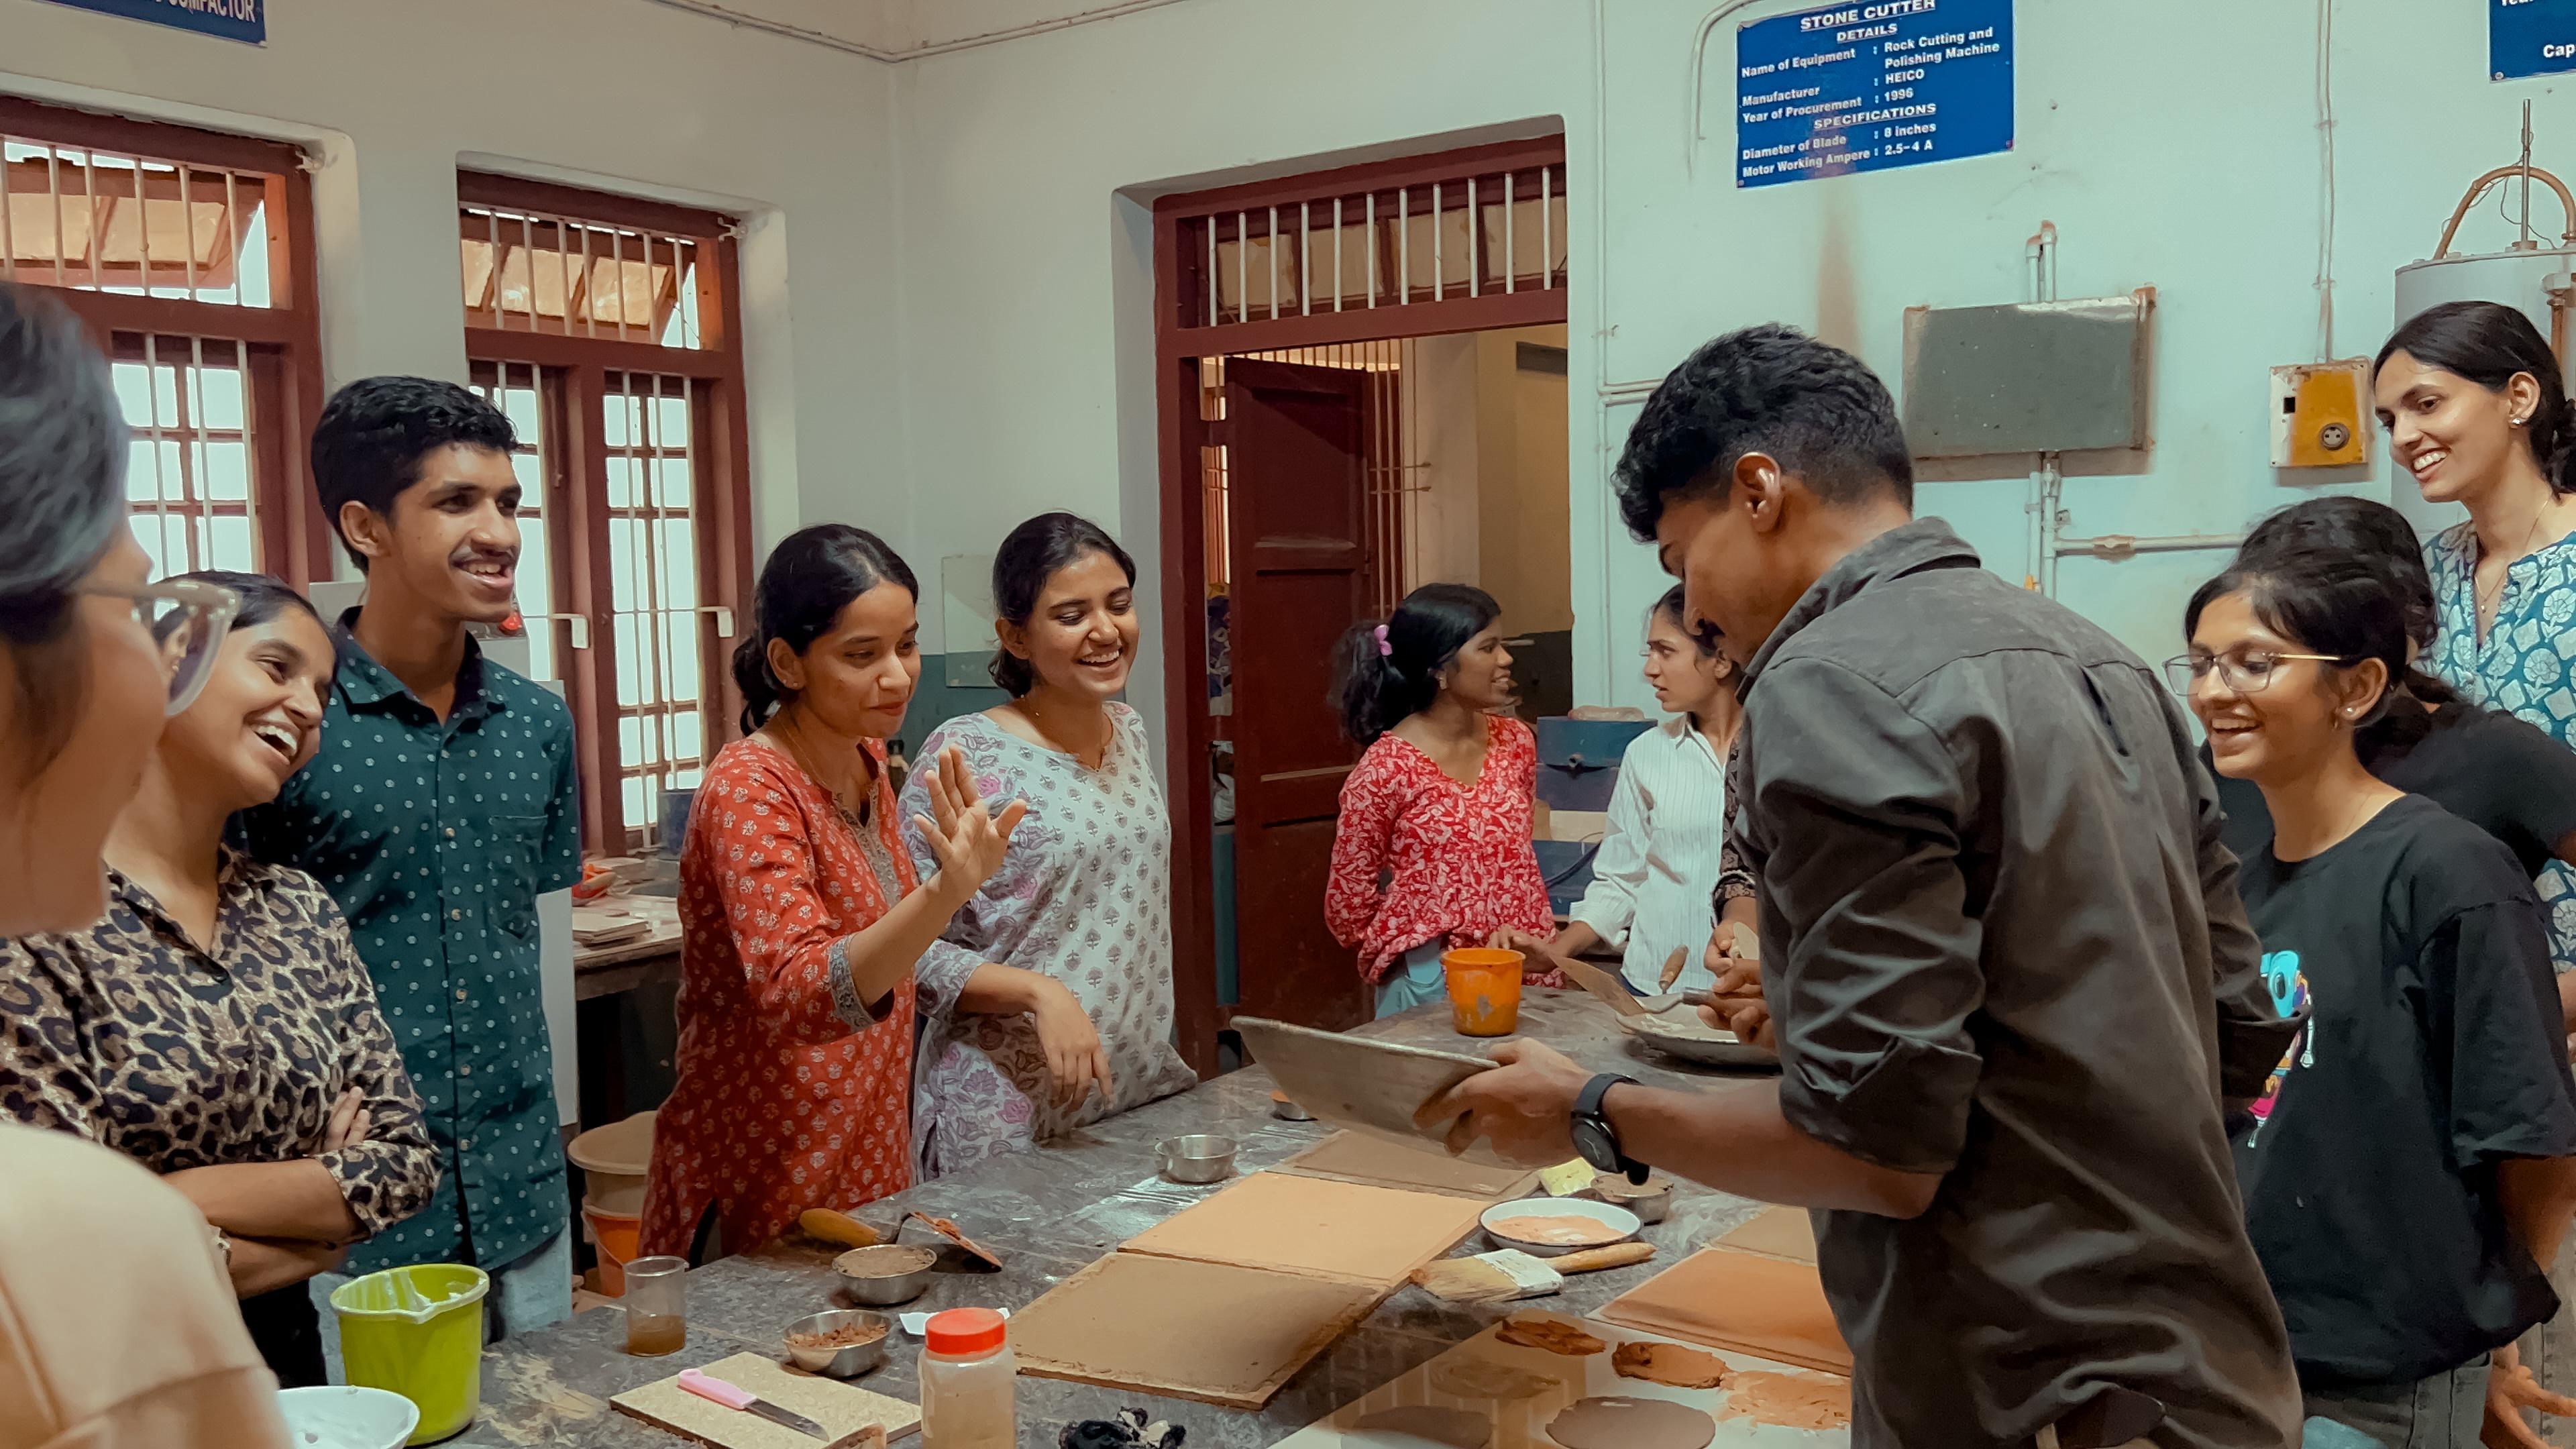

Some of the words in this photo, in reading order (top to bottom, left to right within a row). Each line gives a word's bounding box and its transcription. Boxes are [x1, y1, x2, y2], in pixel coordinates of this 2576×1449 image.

[1801, 9, 1859, 30] STONE
[1864, 0, 1935, 19] CUTTER
[1837, 23, 1898, 42] DETAILS
[1741, 64, 1775, 78] Name
[1778, 58, 1789, 70] of
[1792, 48, 1856, 68] Equipment
[1884, 39, 1915, 52] Rock
[1919, 32, 1965, 47] Cutting
[1968, 26, 1994, 40] and
[1885, 52, 1942, 68] Polishing
[1945, 43, 2000, 59] Machine
[2543, 44, 2576, 58] Cap
[1742, 86, 1820, 106] Manufacturer
[1885, 68, 1925, 85] HEICO
[1742, 112, 1768, 123] Year
[1771, 108, 1782, 119] of
[1785, 97, 1862, 117] Procurement
[1884, 87, 1914, 101] 1996
[1814, 103, 1937, 129] SPECIFICATIONS
[1743, 144, 1795, 160] Diameter
[1798, 140, 1810, 151] of
[1813, 135, 1847, 148] Blade
[1895, 123, 1937, 137] inches
[1743, 164, 1775, 177] Motor
[1777, 157, 1823, 172] Working
[1826, 150, 1870, 164] Ampere
[1924, 140, 1933, 150] A
